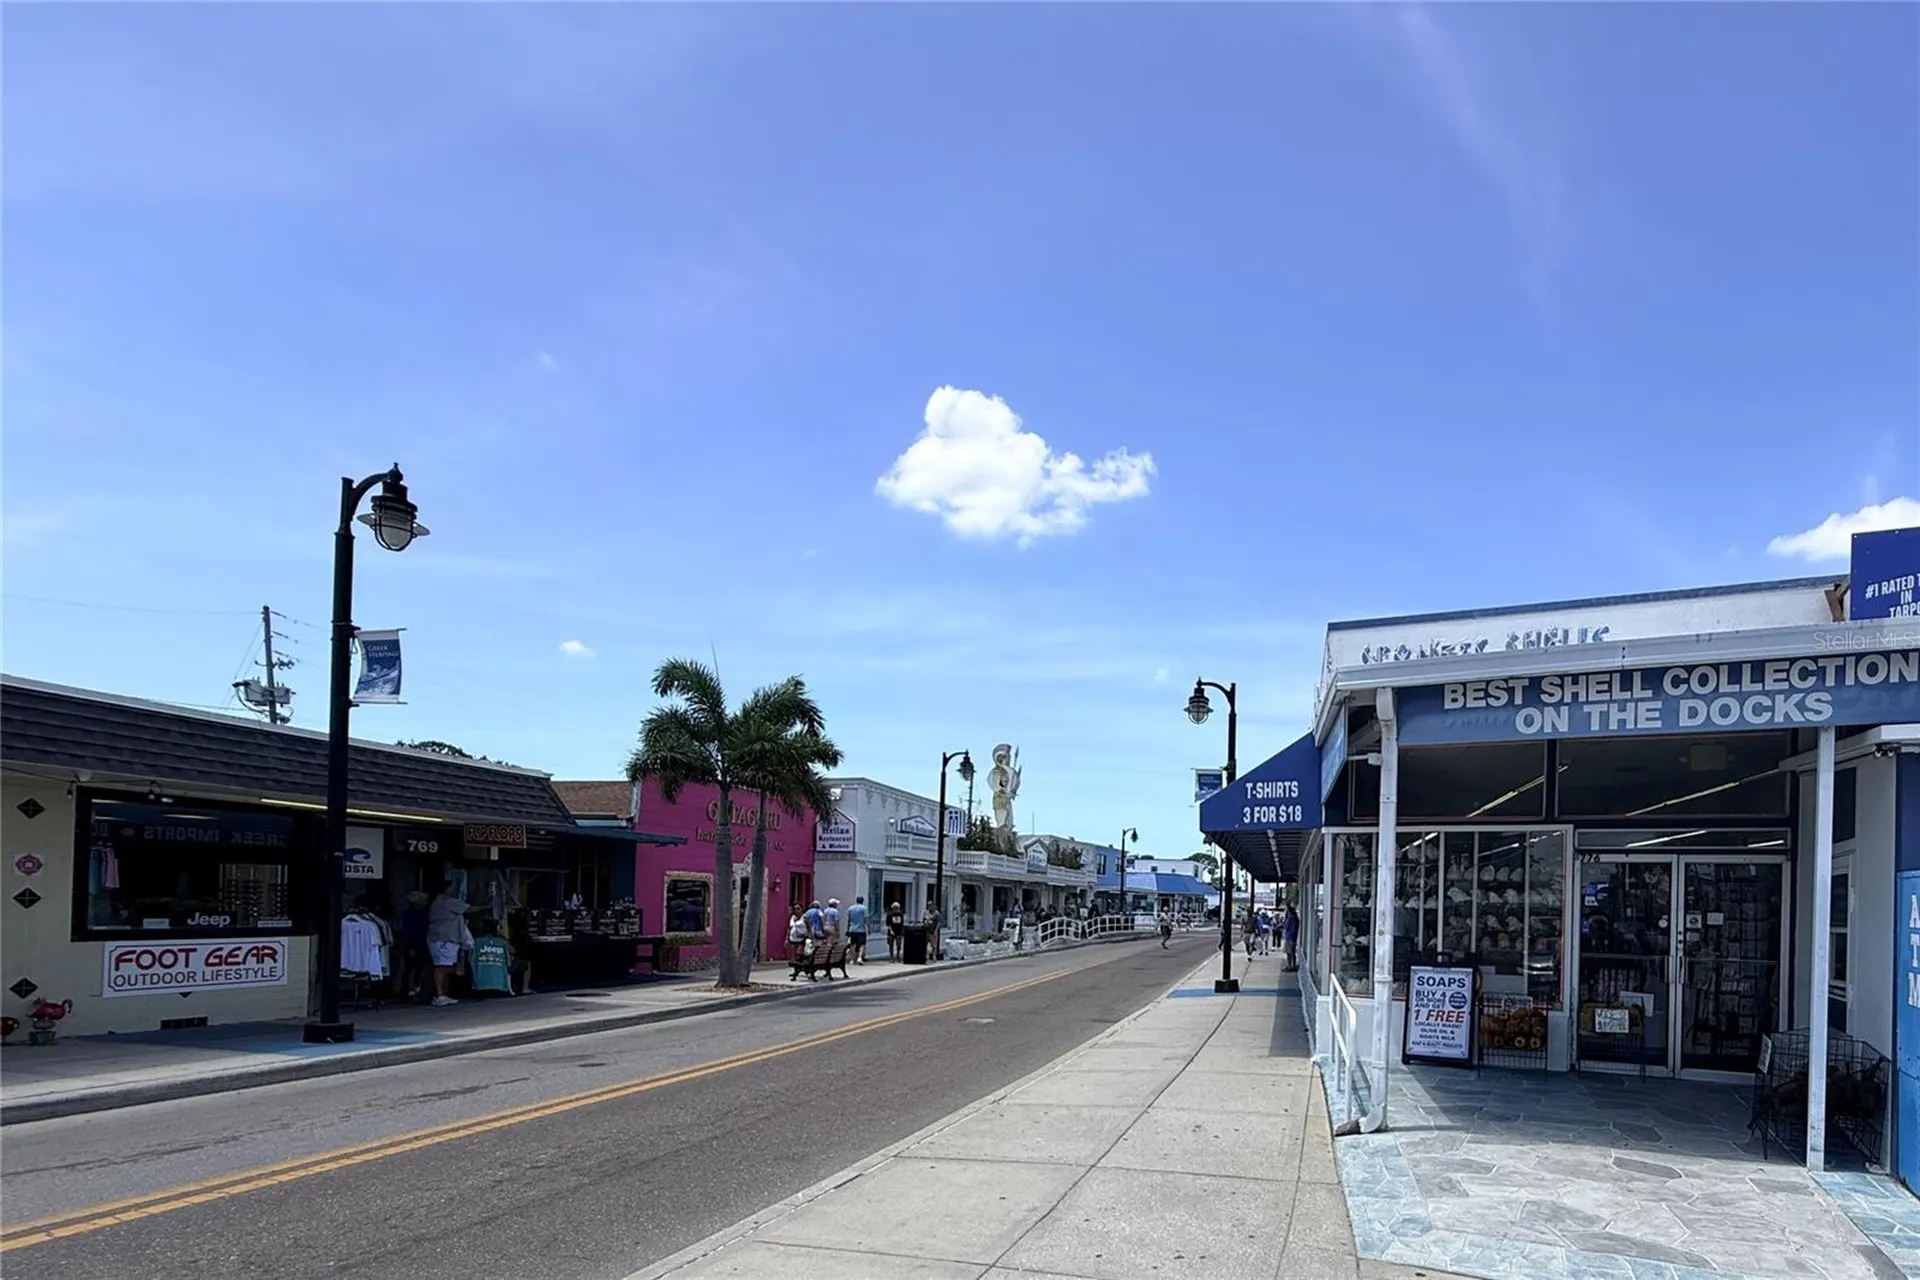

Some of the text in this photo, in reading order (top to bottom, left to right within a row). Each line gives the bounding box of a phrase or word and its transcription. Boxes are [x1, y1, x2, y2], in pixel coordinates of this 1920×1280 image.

[1865, 583, 1879, 599] #1
[1881, 575, 1915, 596] RATED
[1900, 590, 1913, 605] IN
[1443, 651, 1920, 710] BEST SHELL COLLECTION
[1515, 705, 1569, 735] ON
[1583, 700, 1663, 731] THE
[1679, 691, 1833, 727] DOCKS
[1245, 780, 1299, 799] T-SHIRTS
[1242, 804, 1302, 823] 3 FOR $18
[407, 839, 439, 853] 769
[344, 864, 374, 874] OSTA
[186, 911, 231, 928] Jeep
[114, 945, 279, 972] FOOT GEAR
[113, 965, 278, 988] OUTDOOR LIFESTYLE
[1416, 975, 1467, 989] SOAPS
[1415, 990, 1447, 999] BUY 4
[1414, 1009, 1466, 1023] 1 FREE
